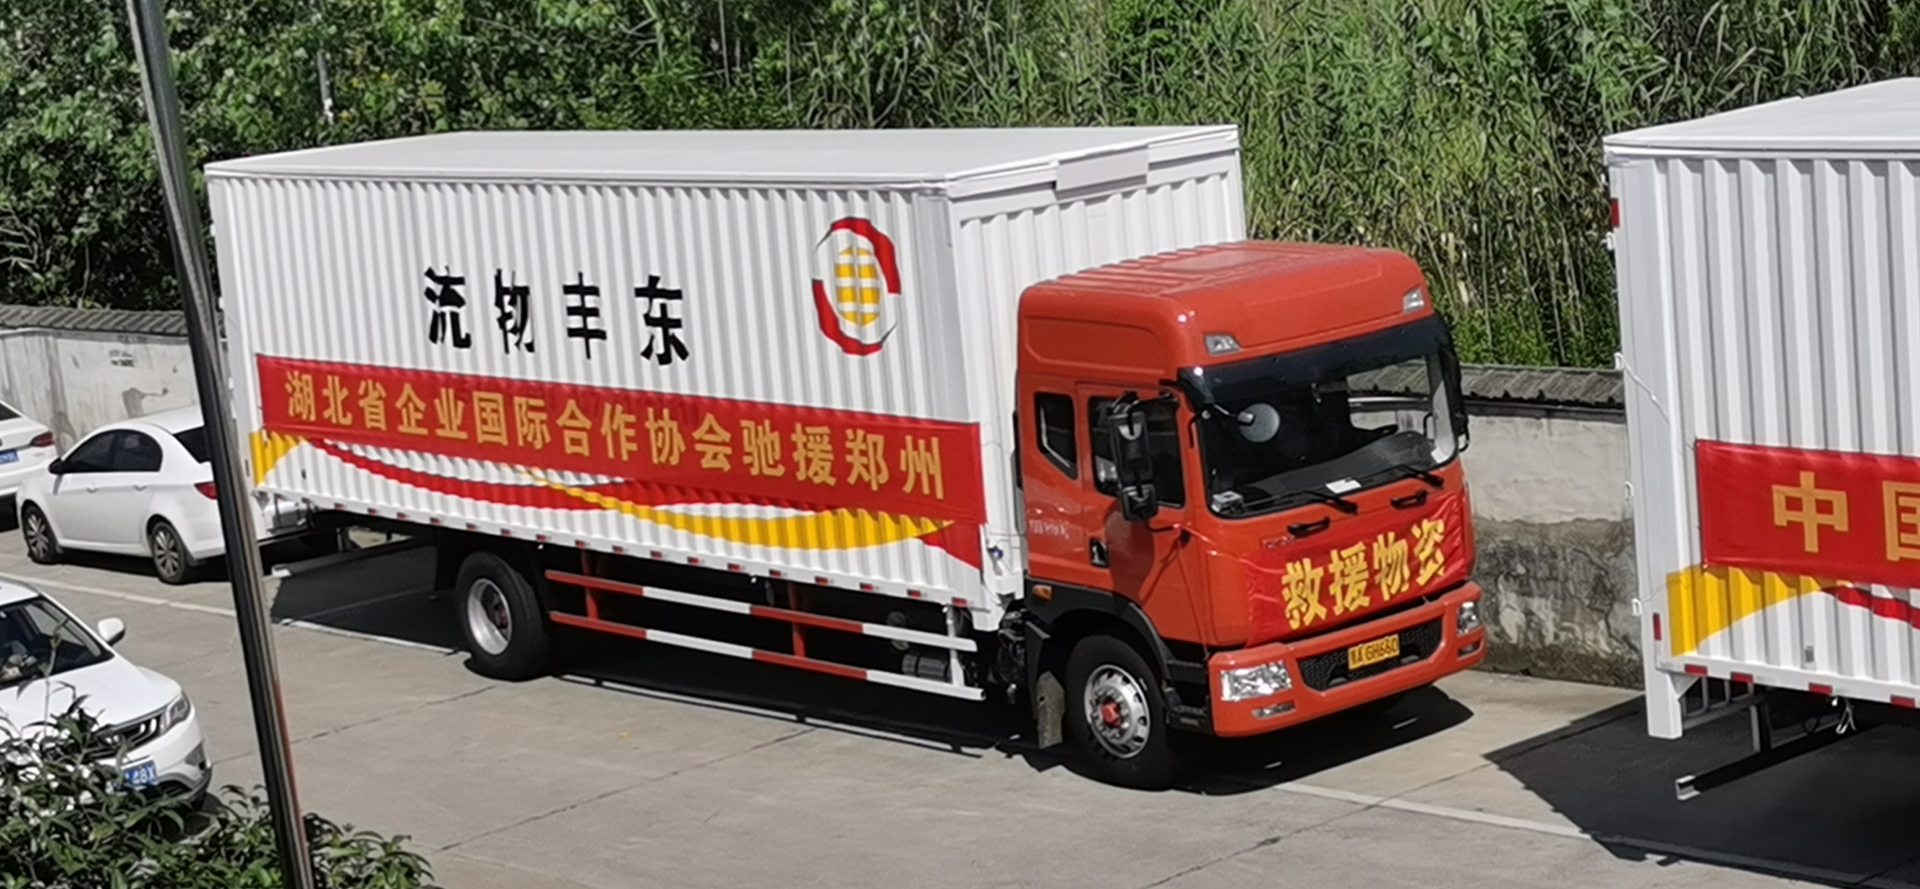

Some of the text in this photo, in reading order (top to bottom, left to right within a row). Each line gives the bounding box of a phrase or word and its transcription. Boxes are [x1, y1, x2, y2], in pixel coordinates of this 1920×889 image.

[285, 370, 944, 499] 湖北省企业国际合作协会驰援郑州
[1281, 519, 1446, 630] 救援物资
